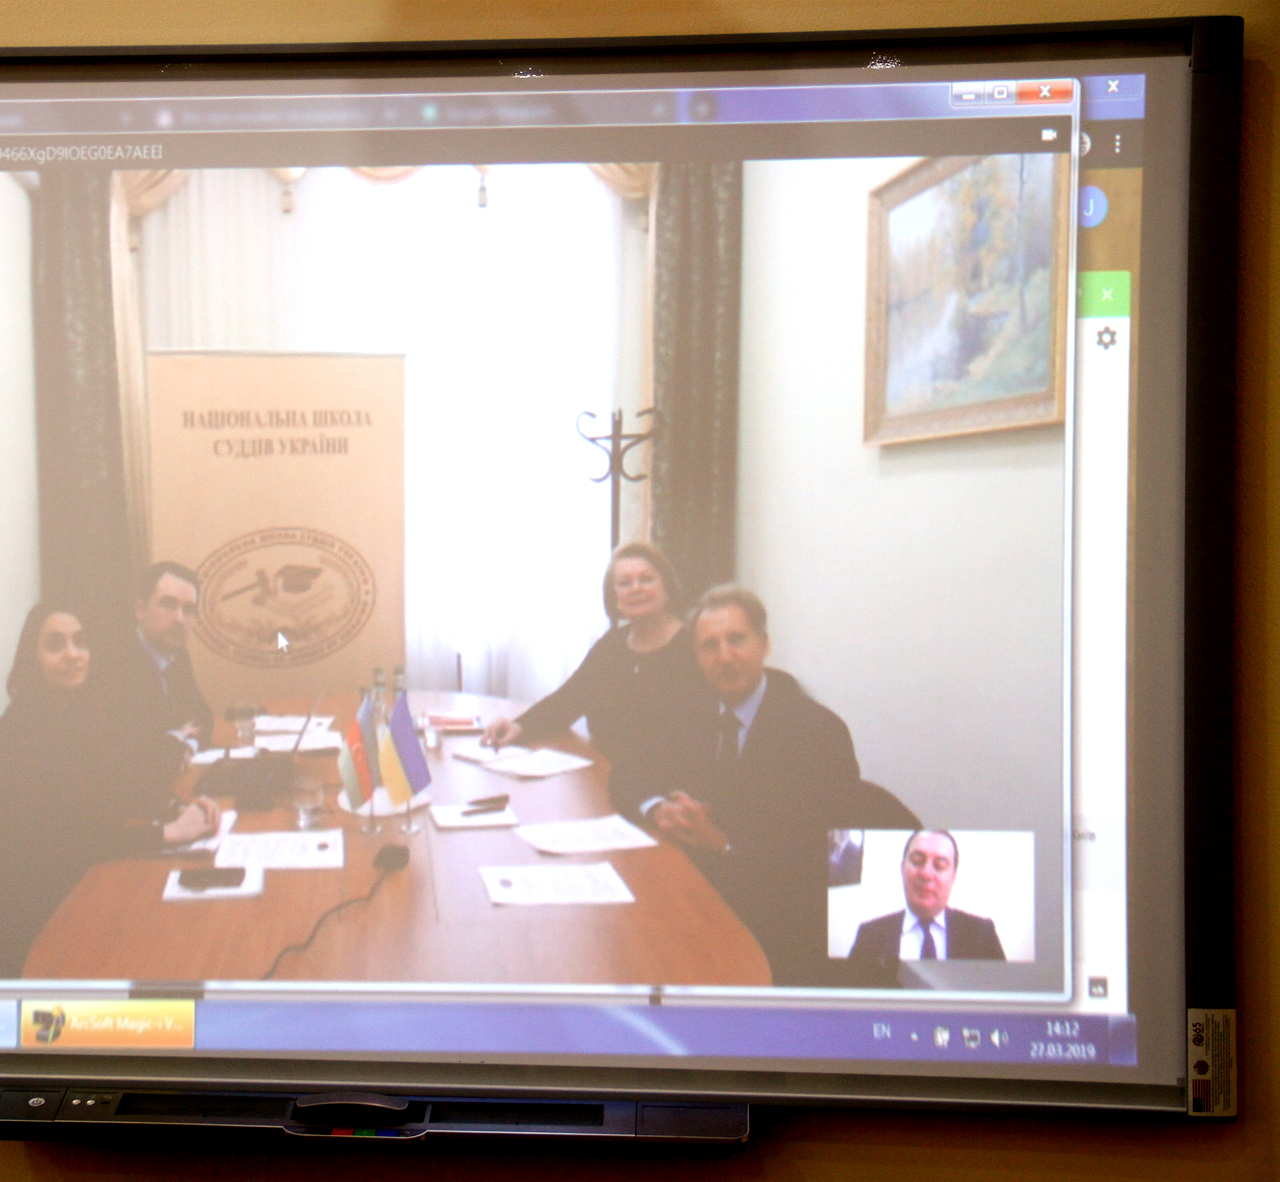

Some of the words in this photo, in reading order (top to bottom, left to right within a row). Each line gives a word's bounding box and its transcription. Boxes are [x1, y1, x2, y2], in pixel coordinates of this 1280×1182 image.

[182, 409, 308, 430] НАЦІОНАЛЬНА
[312, 409, 372, 428] ШКОЛА
[213, 437, 276, 459] СУДДІВ
[278, 433, 349, 455] УКРАЇНИ
[873, 1022, 891, 1039] EN
[1046, 1020, 1080, 1037] 14:12
[1030, 1042, 1097, 1060] 27.03.2019
